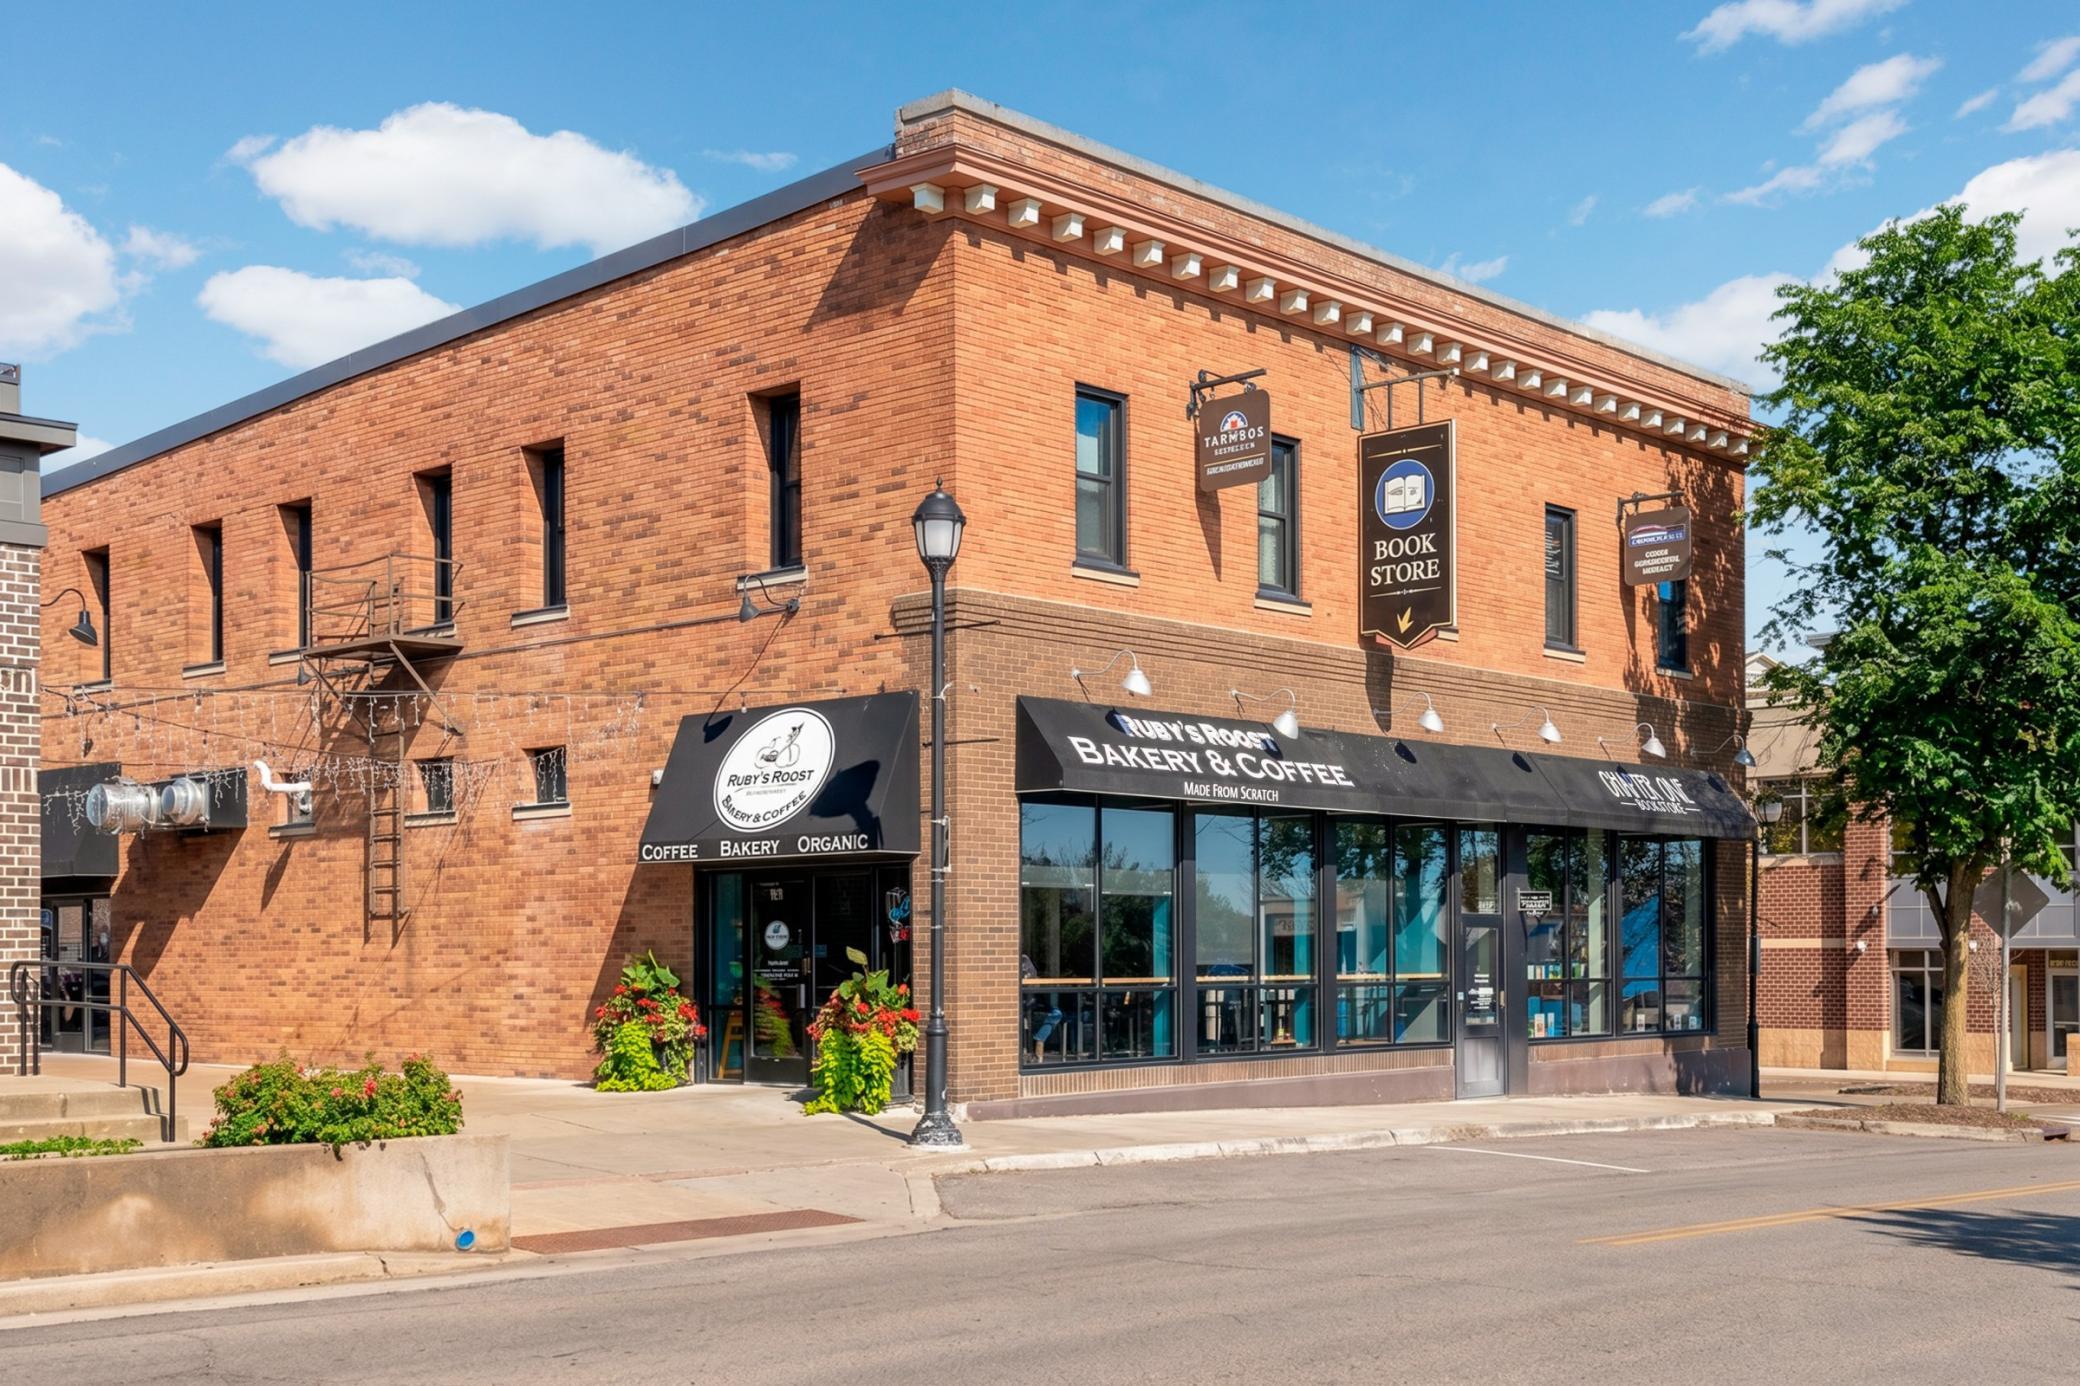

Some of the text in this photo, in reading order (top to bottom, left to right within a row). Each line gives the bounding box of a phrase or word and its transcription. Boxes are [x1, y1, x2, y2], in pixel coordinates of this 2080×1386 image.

[1204, 426, 1264, 448] TARMBOS
[1374, 533, 1438, 561] BOOK
[1370, 558, 1440, 586] STORE
[1114, 714, 1277, 751] RUBY'S ROOST
[1067, 735, 1355, 788] BAKERY & COFFEE
[727, 770, 814, 787] RUBY'S ROOST
[1184, 781, 1279, 802] MADE FROM SCRATCH
[1656, 777, 1696, 804] ONE
[722, 790, 807, 823] BAKERY & COFFEE
[642, 834, 869, 860] COFFEE BAKERY ORGANIC
